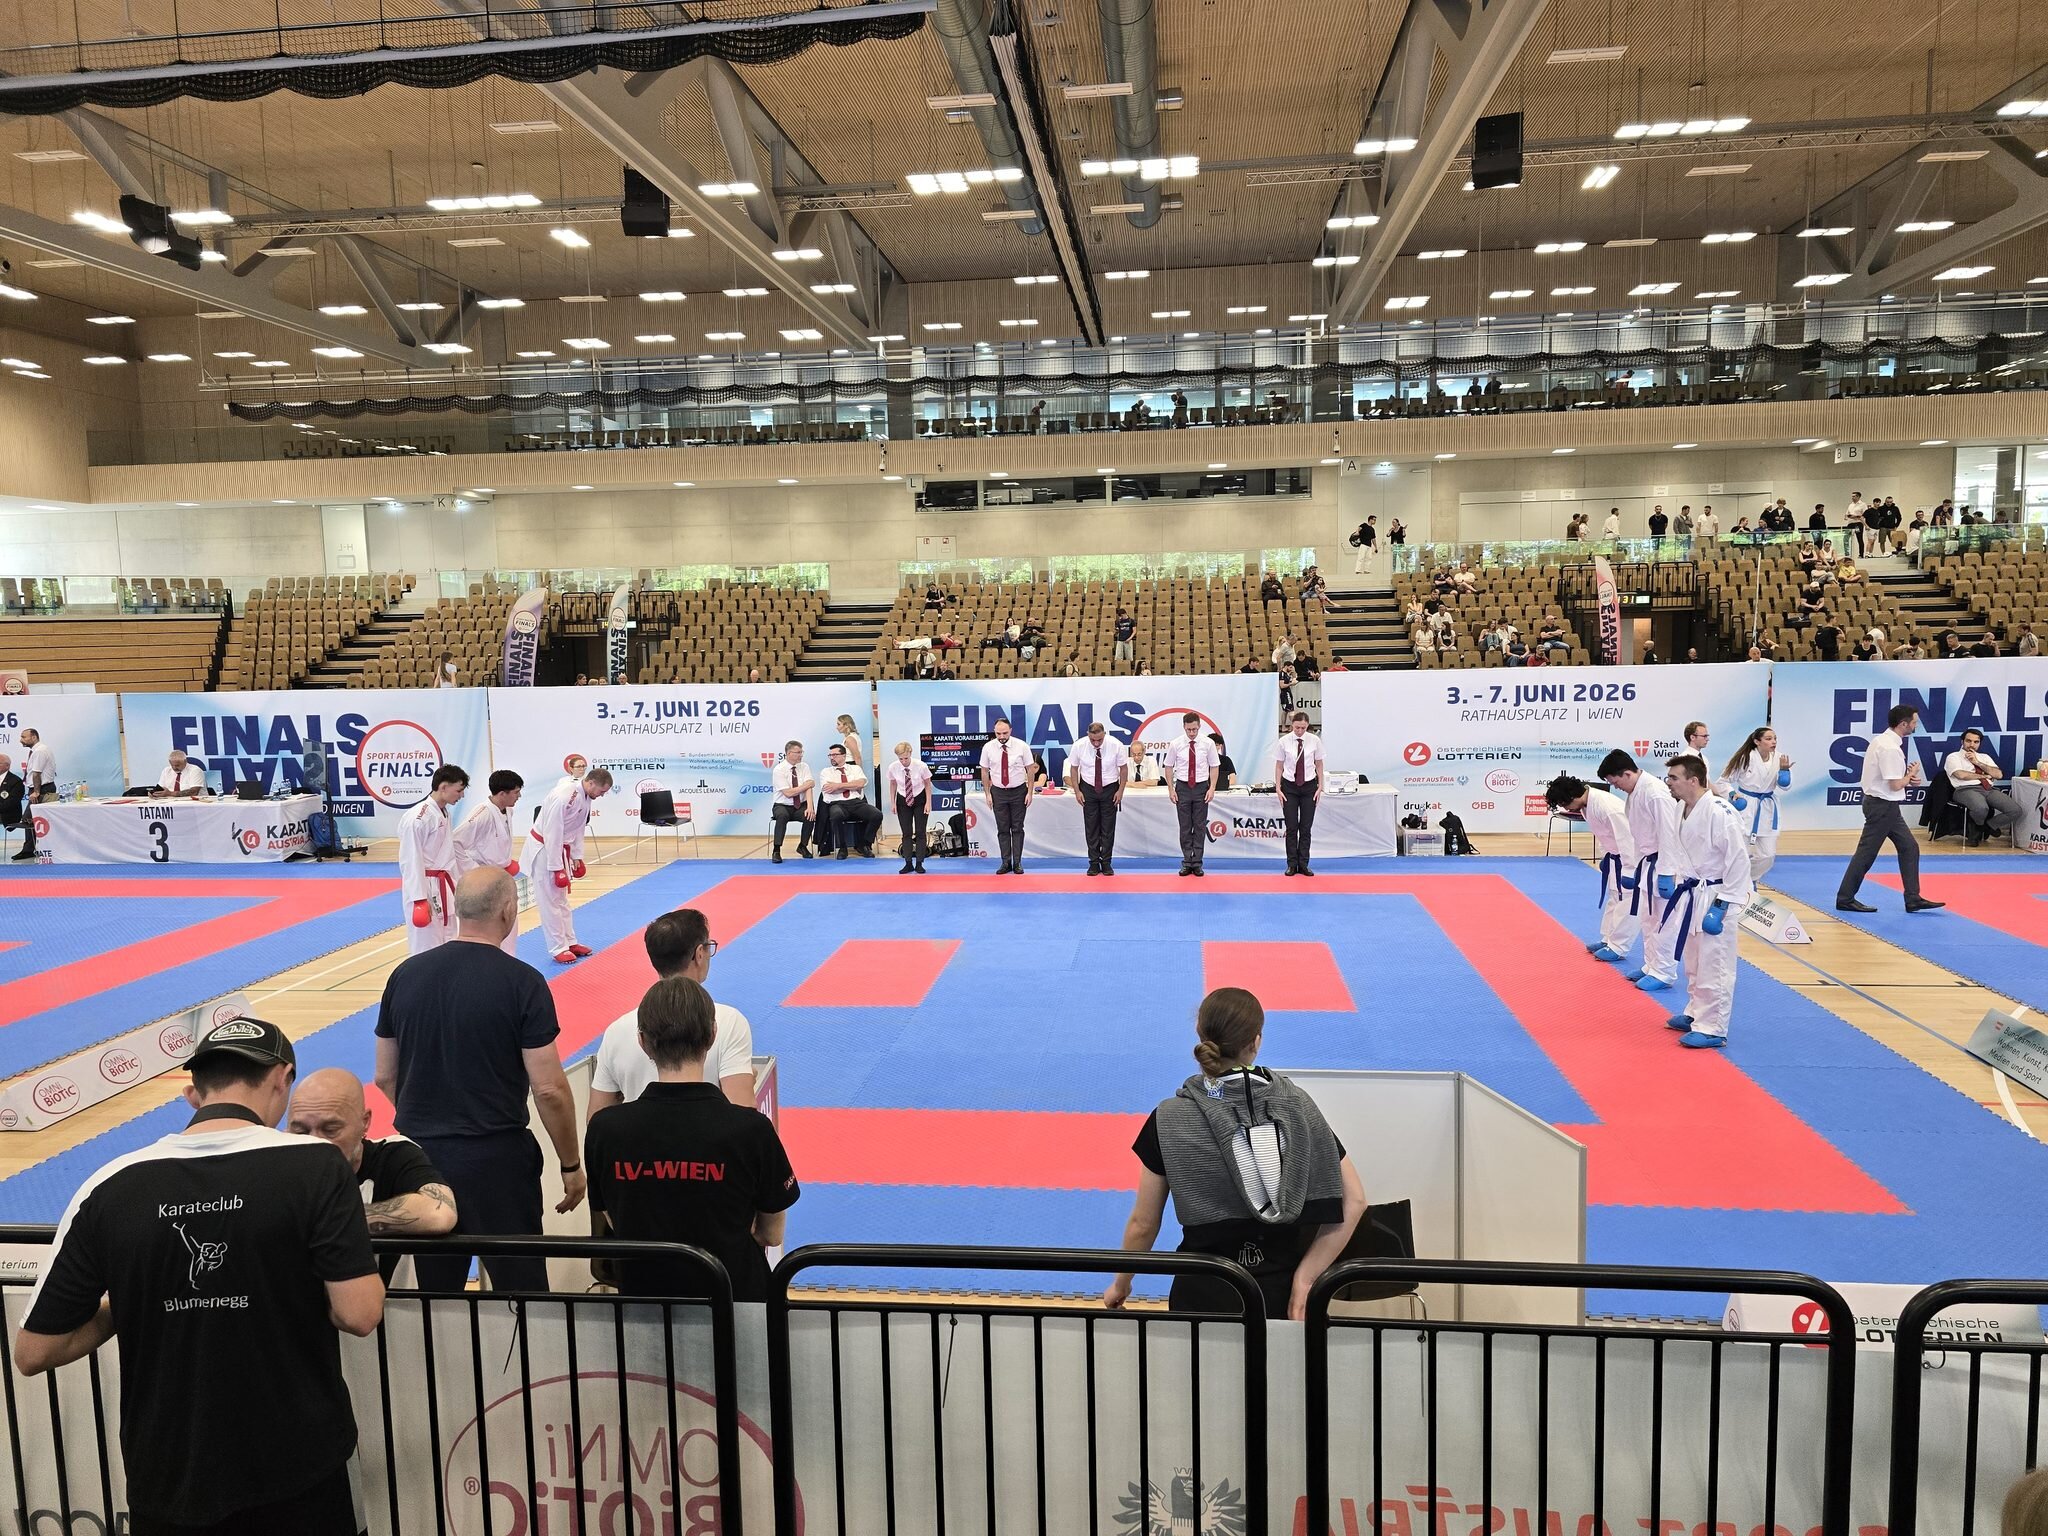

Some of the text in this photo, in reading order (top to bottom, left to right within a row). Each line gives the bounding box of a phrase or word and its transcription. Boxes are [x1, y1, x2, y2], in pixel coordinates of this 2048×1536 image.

[1850, 447, 1857, 457] B
[1347, 460, 1356, 470] A
[911, 478, 916, 487] L
[438, 498, 445, 507] K
[1514, 685, 1565, 707] JUNI
[1573, 683, 1636, 702] 2026
[1296, 698, 1321, 708] druc
[655, 701, 699, 721] JUNI
[706, 700, 760, 717] 2026
[1461, 708, 1568, 721] RATHAUSPLATZ
[1588, 708, 1623, 720] WIEN
[1833, 685, 2048, 735] FINAL
[610, 723, 702, 735] RATHAUSPLATZ
[720, 722, 750, 734] WIEN
[171, 713, 369, 757] FINALS
[1654, 740, 1679, 748] Stadt
[397, 751, 433, 759] AUSTRIA
[1654, 750, 1679, 758] Wien
[368, 762, 435, 777] FINALS
[1840, 791, 1861, 802] DIE
[942, 798, 960, 808] DIE
[138, 807, 173, 819] TATAMI
[267, 819, 309, 839] KARAT
[1233, 818, 1286, 829] KARAT
[149, 822, 169, 862] 3
[2030, 833, 2048, 843] KARA
[2028, 842, 2048, 852] AUST
[1997, 1038, 2041, 1070] Wohnen, Kunst,
[1989, 1049, 2042, 1085] Medien und Sport
[614, 1160, 725, 1181] LV-WIEN
[158, 1195, 244, 1218] Karateclub
[163, 1294, 249, 1312] Blumenegg
